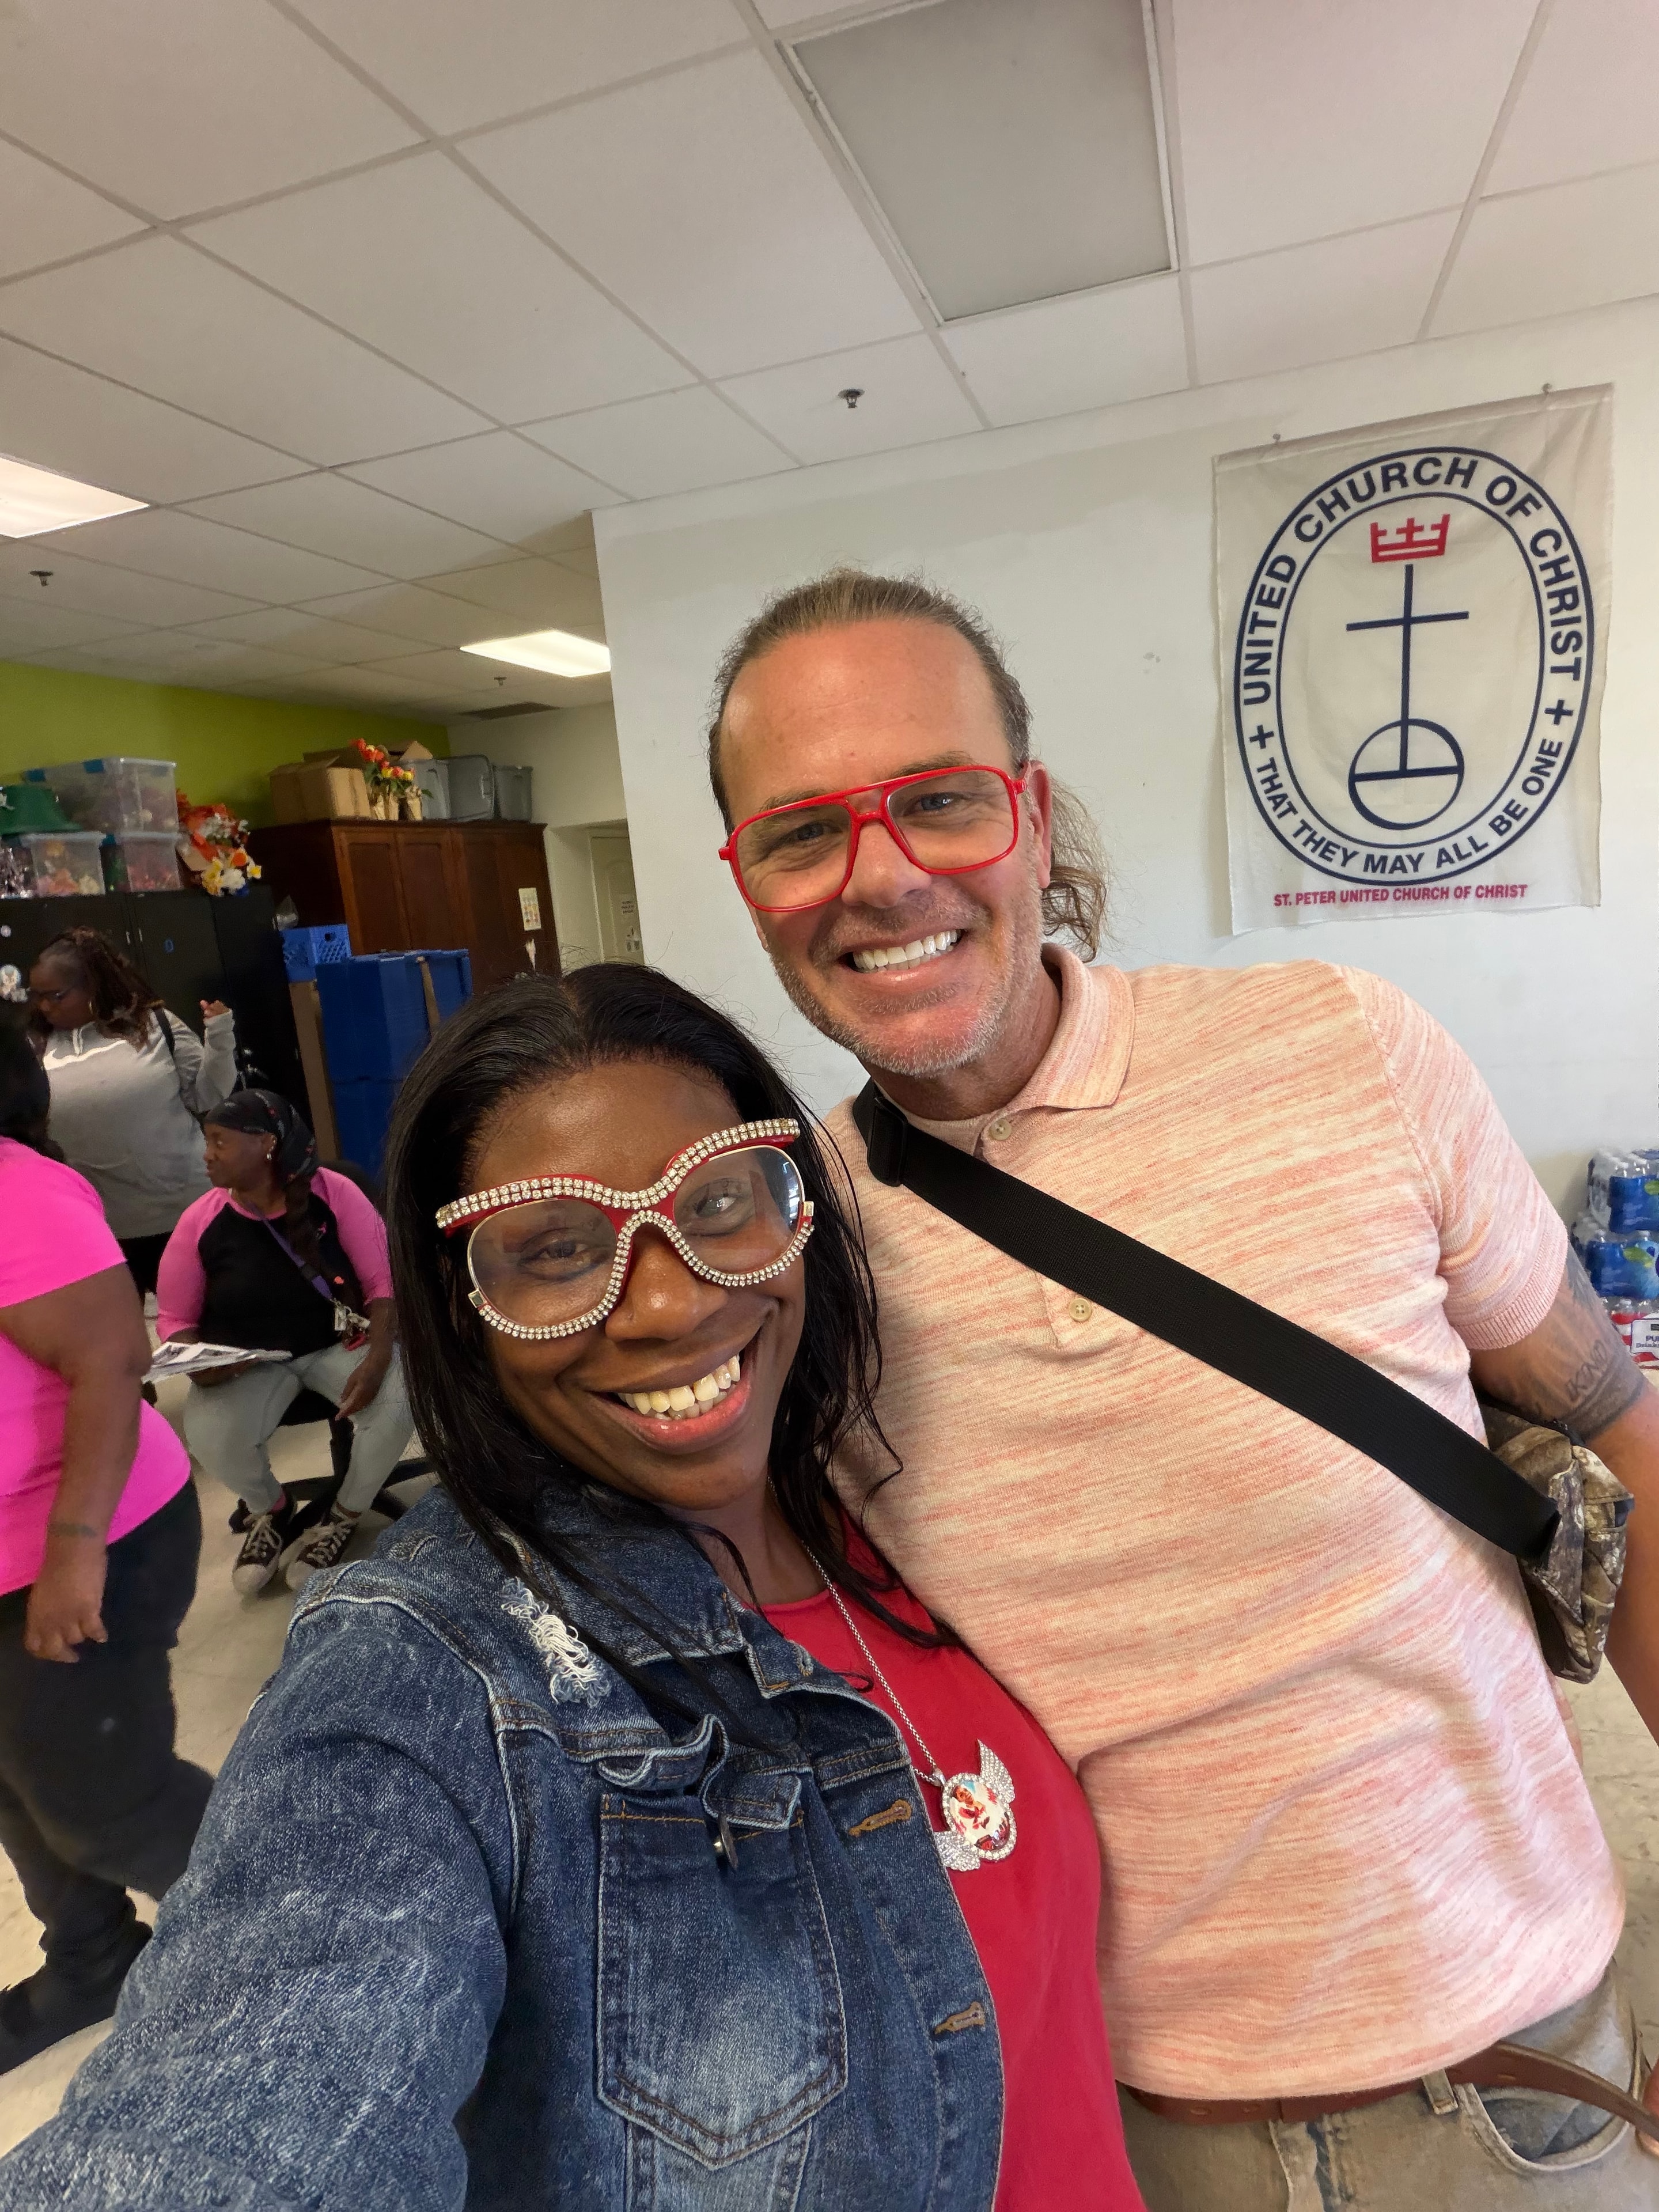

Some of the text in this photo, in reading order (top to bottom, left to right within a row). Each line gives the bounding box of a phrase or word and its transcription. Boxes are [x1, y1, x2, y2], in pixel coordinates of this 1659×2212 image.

[1243, 456, 1583, 706] UNITED CHURCH OF CHRIST
[1256, 738, 1563, 874] THAT THEY MAY ALL BE ONE
[1274, 884, 1528, 906] ST. PETER UNITED CHURCH OF CHRIST
